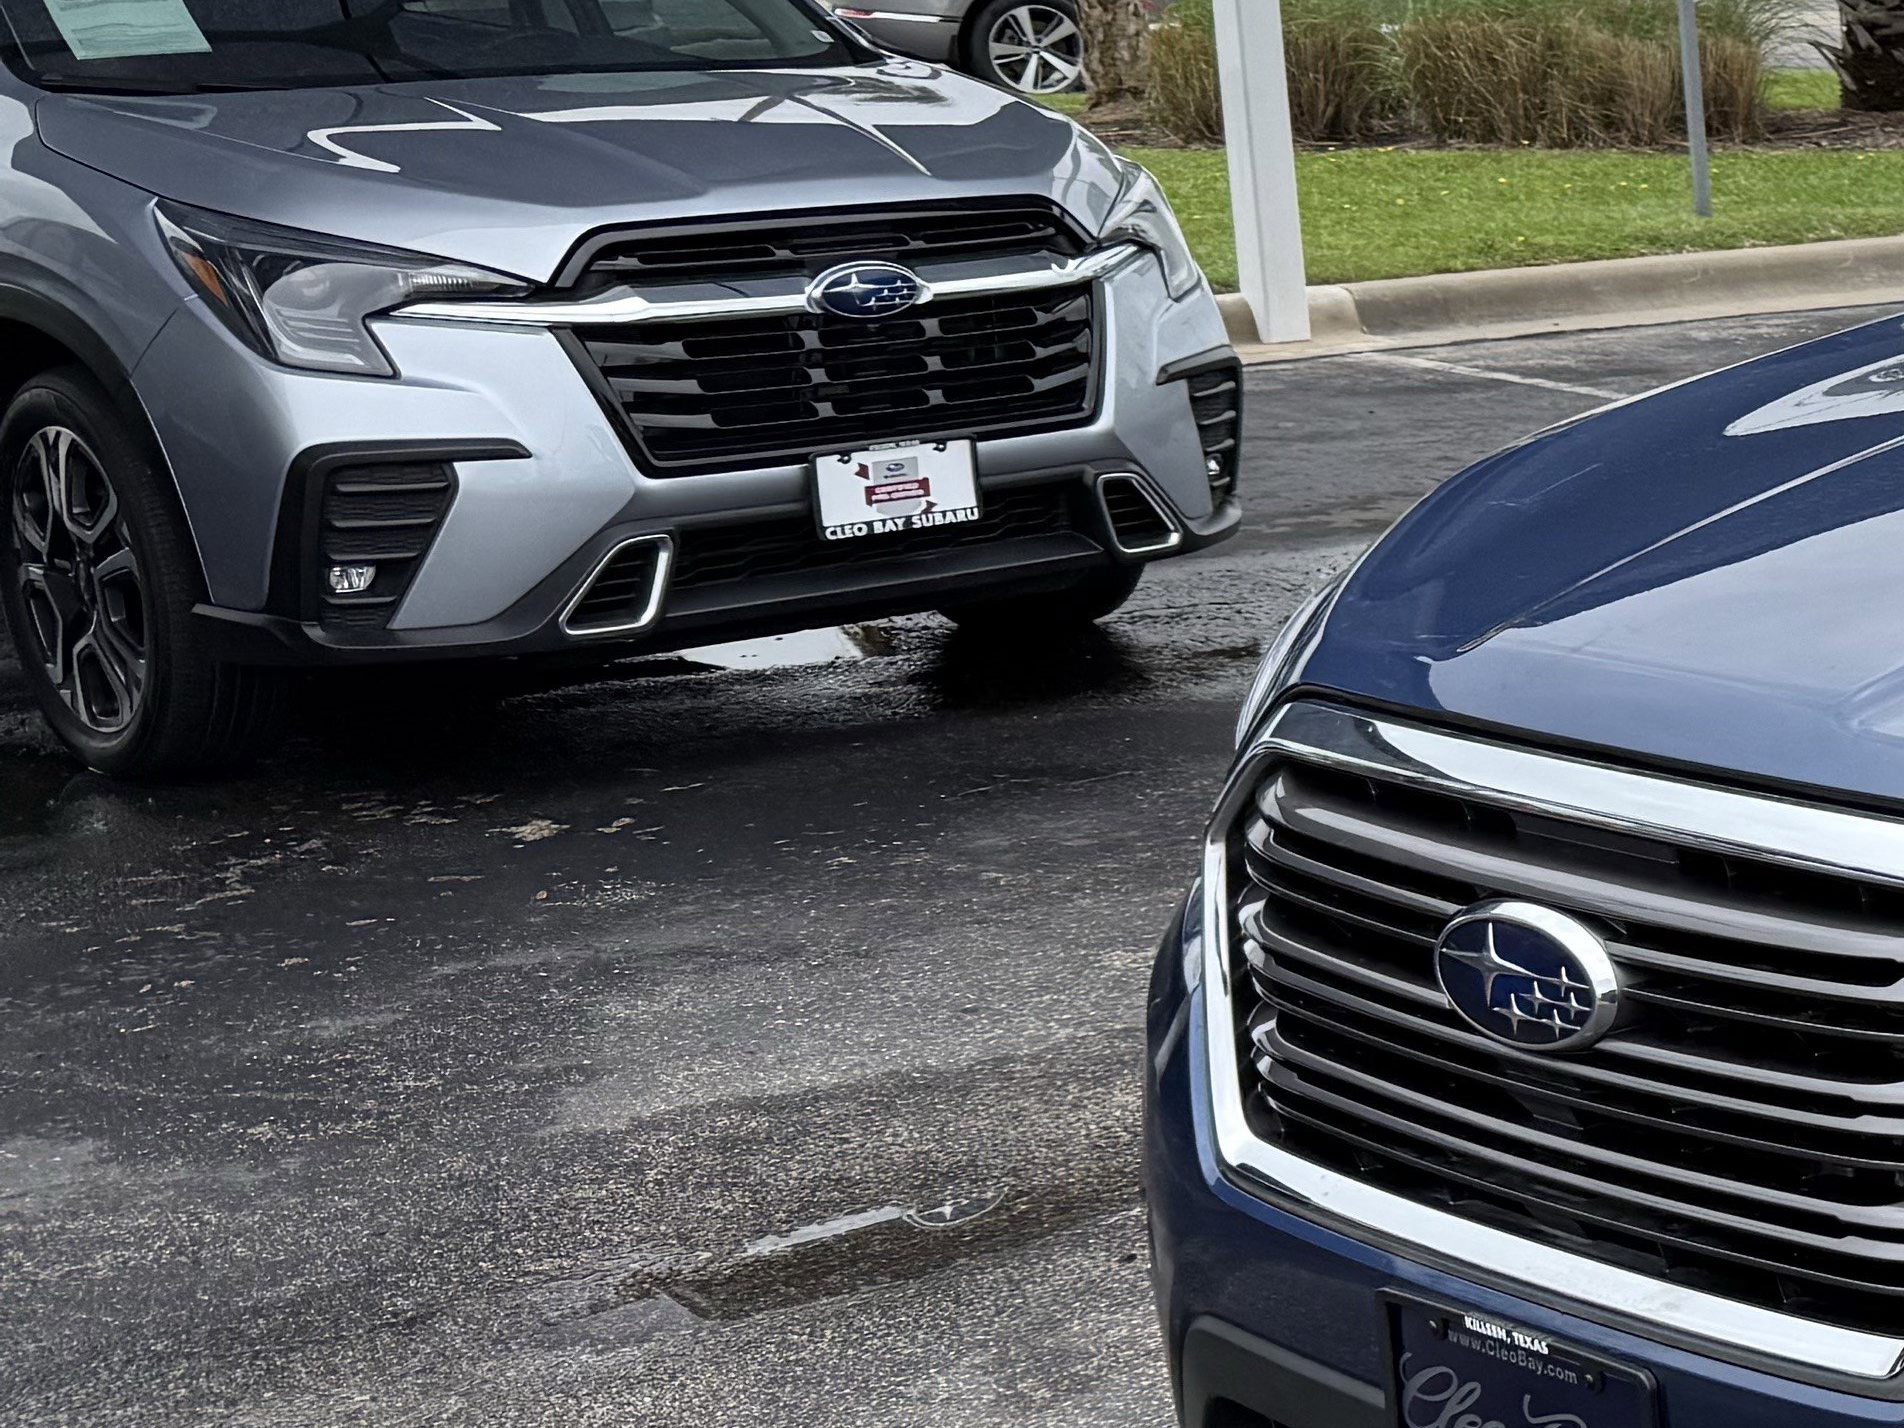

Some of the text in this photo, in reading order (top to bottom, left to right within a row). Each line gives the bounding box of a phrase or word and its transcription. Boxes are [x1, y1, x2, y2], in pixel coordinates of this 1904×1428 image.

[825, 507, 979, 540] CLEO BAY SUBARU
[1448, 1329, 1578, 1384] www.CleoBay.com
[1512, 1332, 1549, 1354] TEXAS
